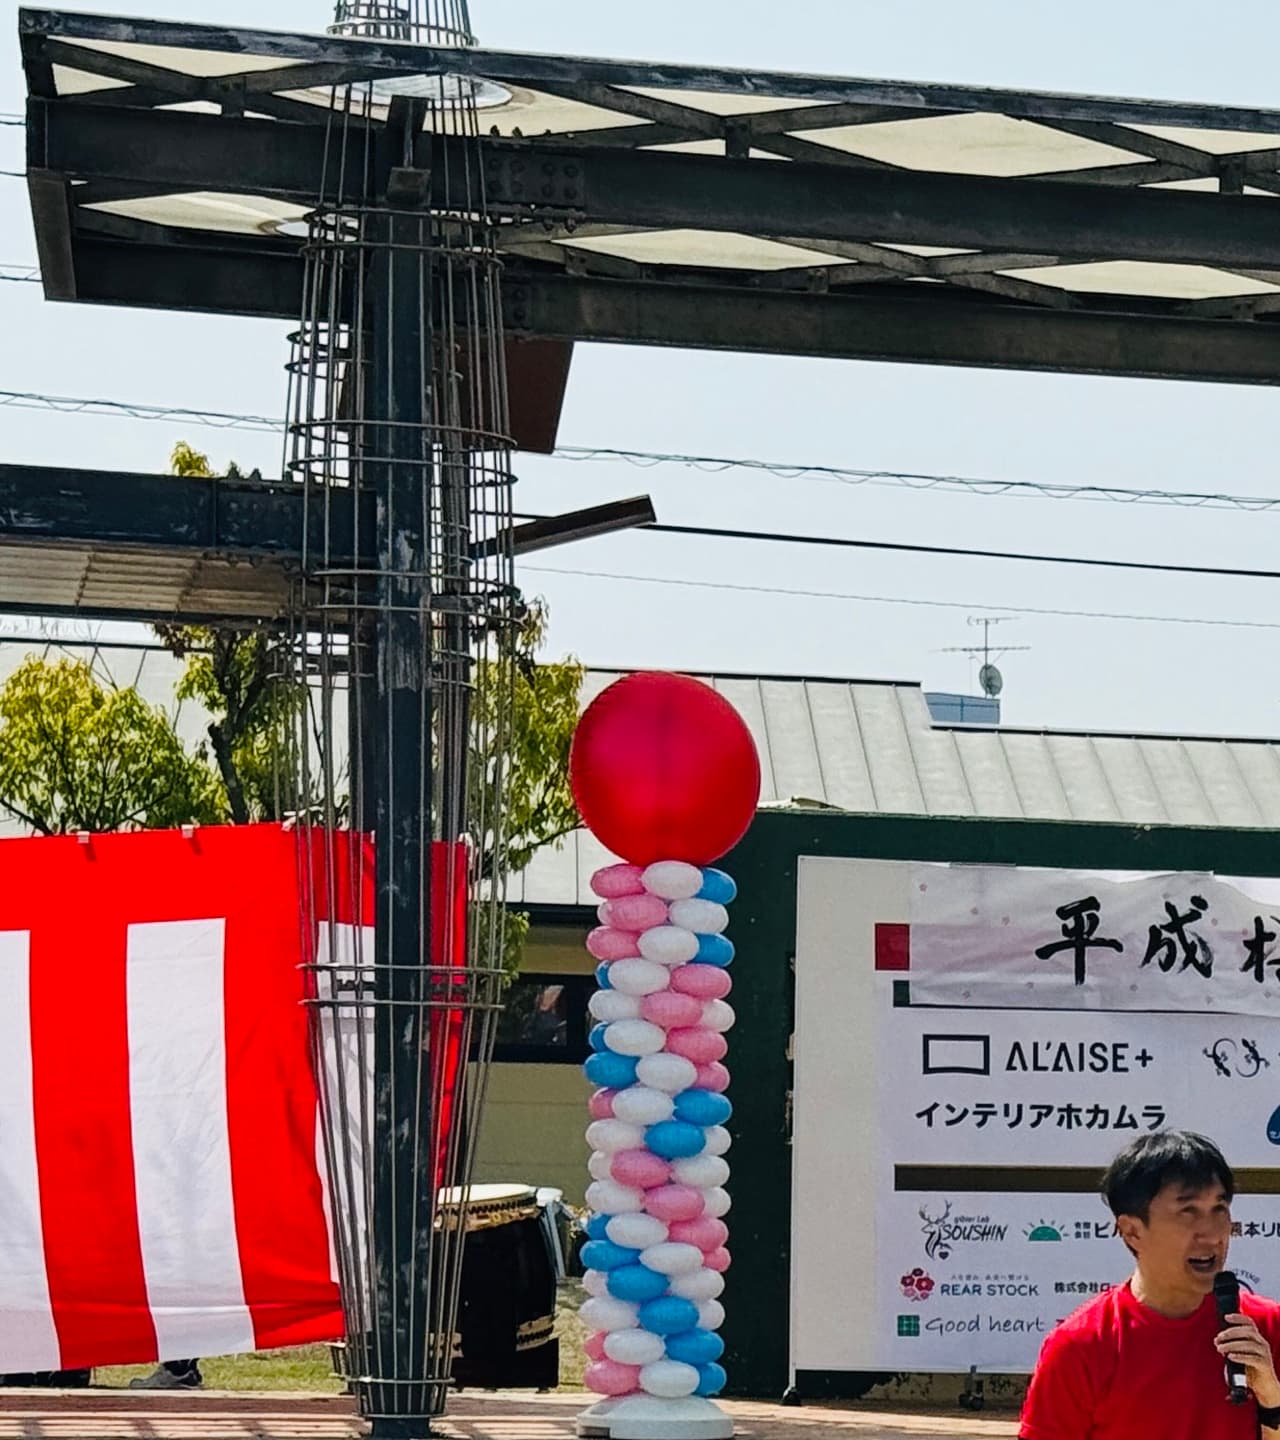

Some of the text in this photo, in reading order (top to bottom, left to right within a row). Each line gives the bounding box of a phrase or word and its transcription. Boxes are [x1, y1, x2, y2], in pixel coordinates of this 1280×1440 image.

[915, 1101, 1166, 1131] インテリアホカムラ
[940, 1283, 1040, 1297] REAR STOCK
[925, 1314, 981, 1337] Good
[988, 1314, 1046, 1333] heart
